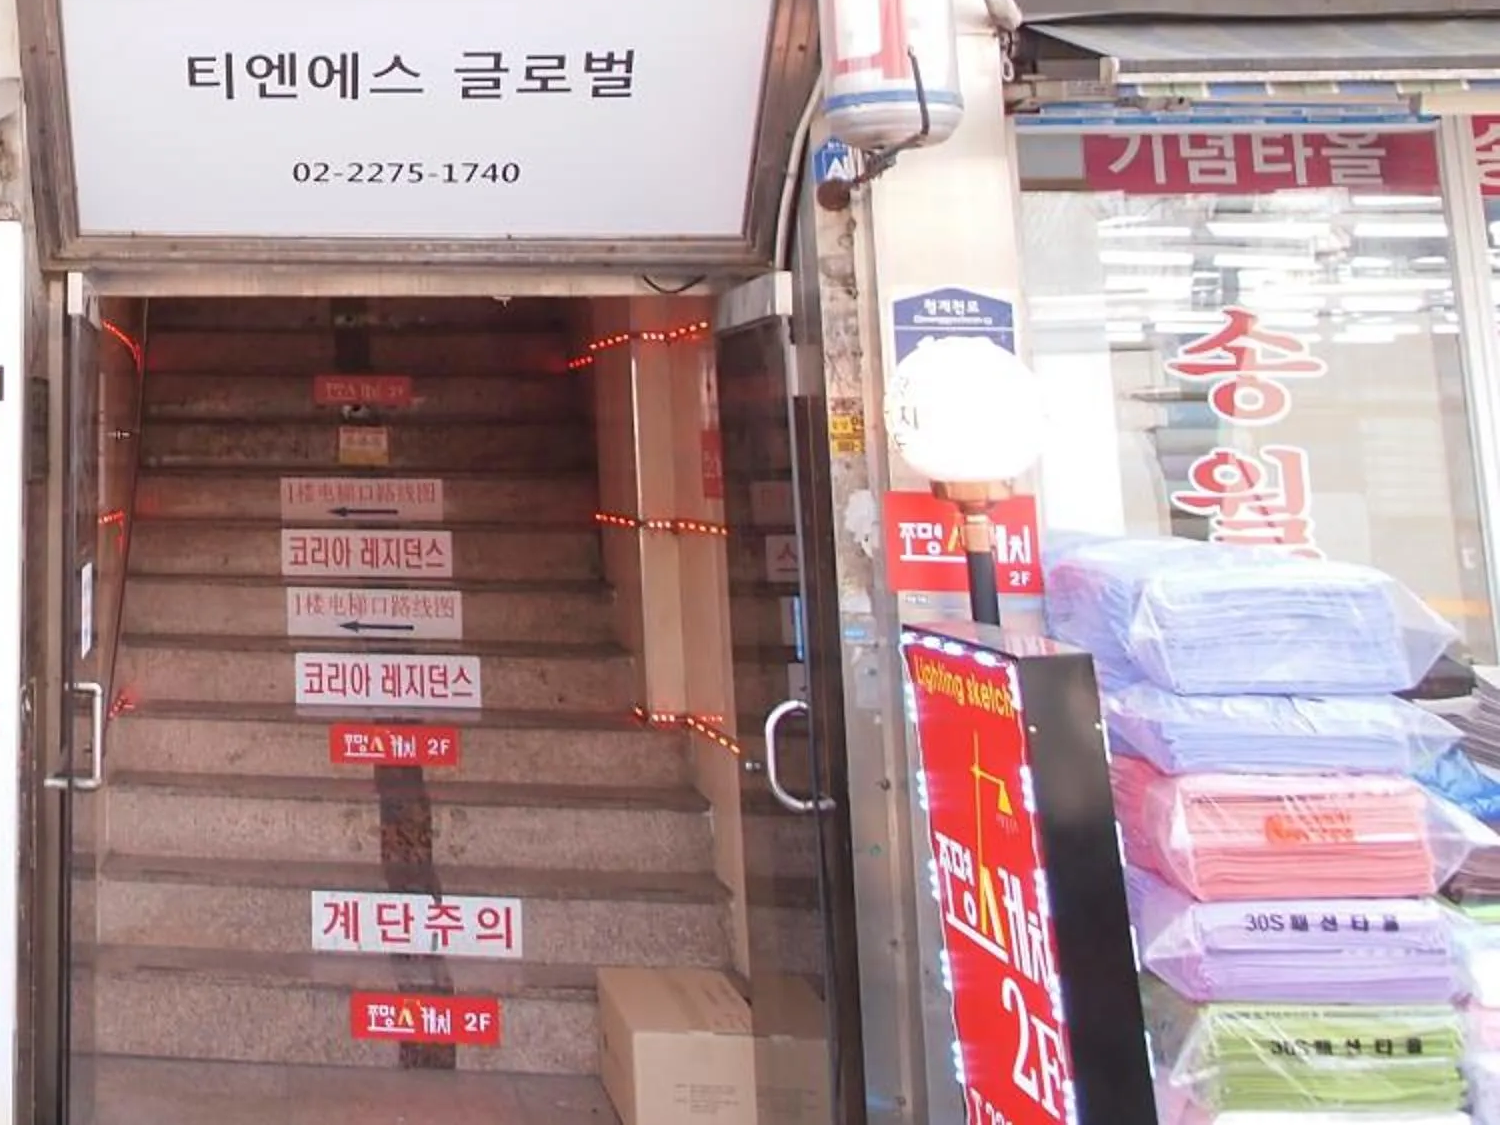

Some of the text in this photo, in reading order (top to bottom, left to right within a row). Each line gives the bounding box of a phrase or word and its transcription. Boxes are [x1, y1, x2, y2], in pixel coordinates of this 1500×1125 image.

[187, 50, 636, 100] 티엔에스 글로벌
[293, 162, 520, 184] 02-2275-1740
[289, 536, 445, 569] 코리아 레지던스
[1009, 570, 1032, 587] 2F
[304, 662, 474, 699] 코리아 레지던스
[427, 738, 451, 757] 2F
[464, 1012, 492, 1032] 2F
[1002, 977, 1062, 1120] 2F
